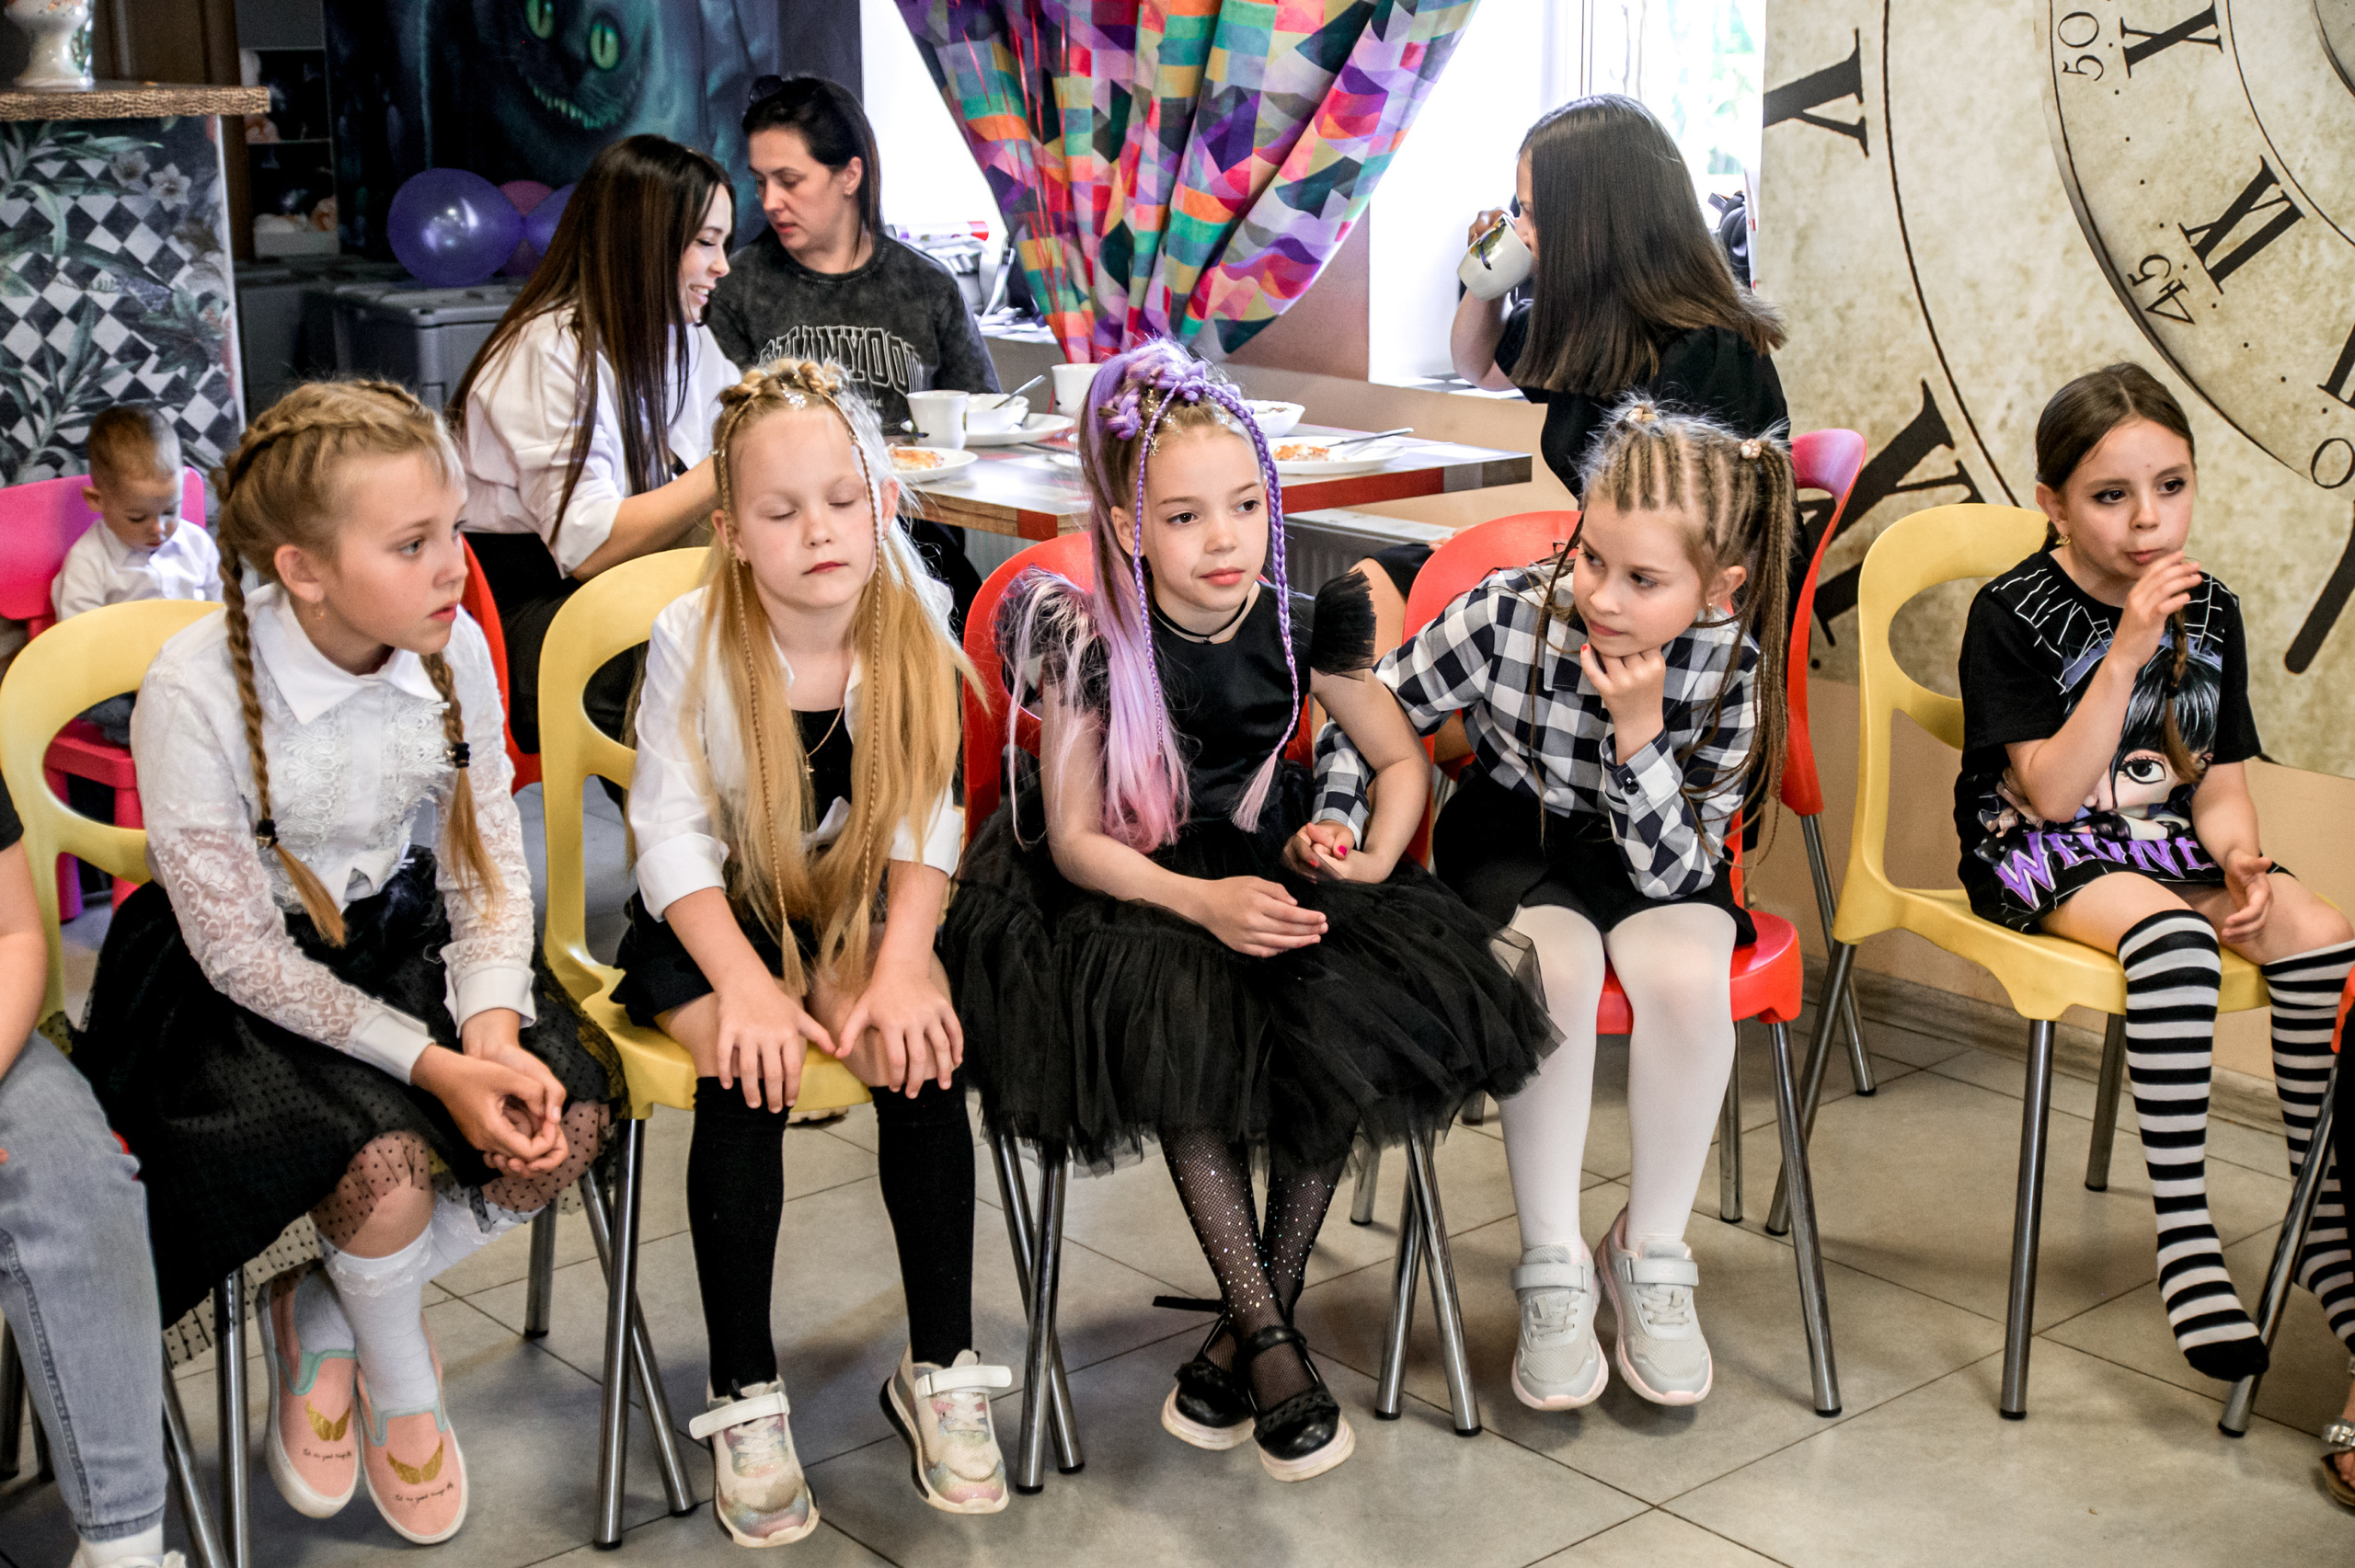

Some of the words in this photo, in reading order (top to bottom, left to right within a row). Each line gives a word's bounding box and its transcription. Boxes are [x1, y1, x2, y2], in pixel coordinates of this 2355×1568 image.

[2058, 11, 2104, 81] 50
[2120, 3, 2223, 79] X
[2127, 254, 2196, 325] 45
